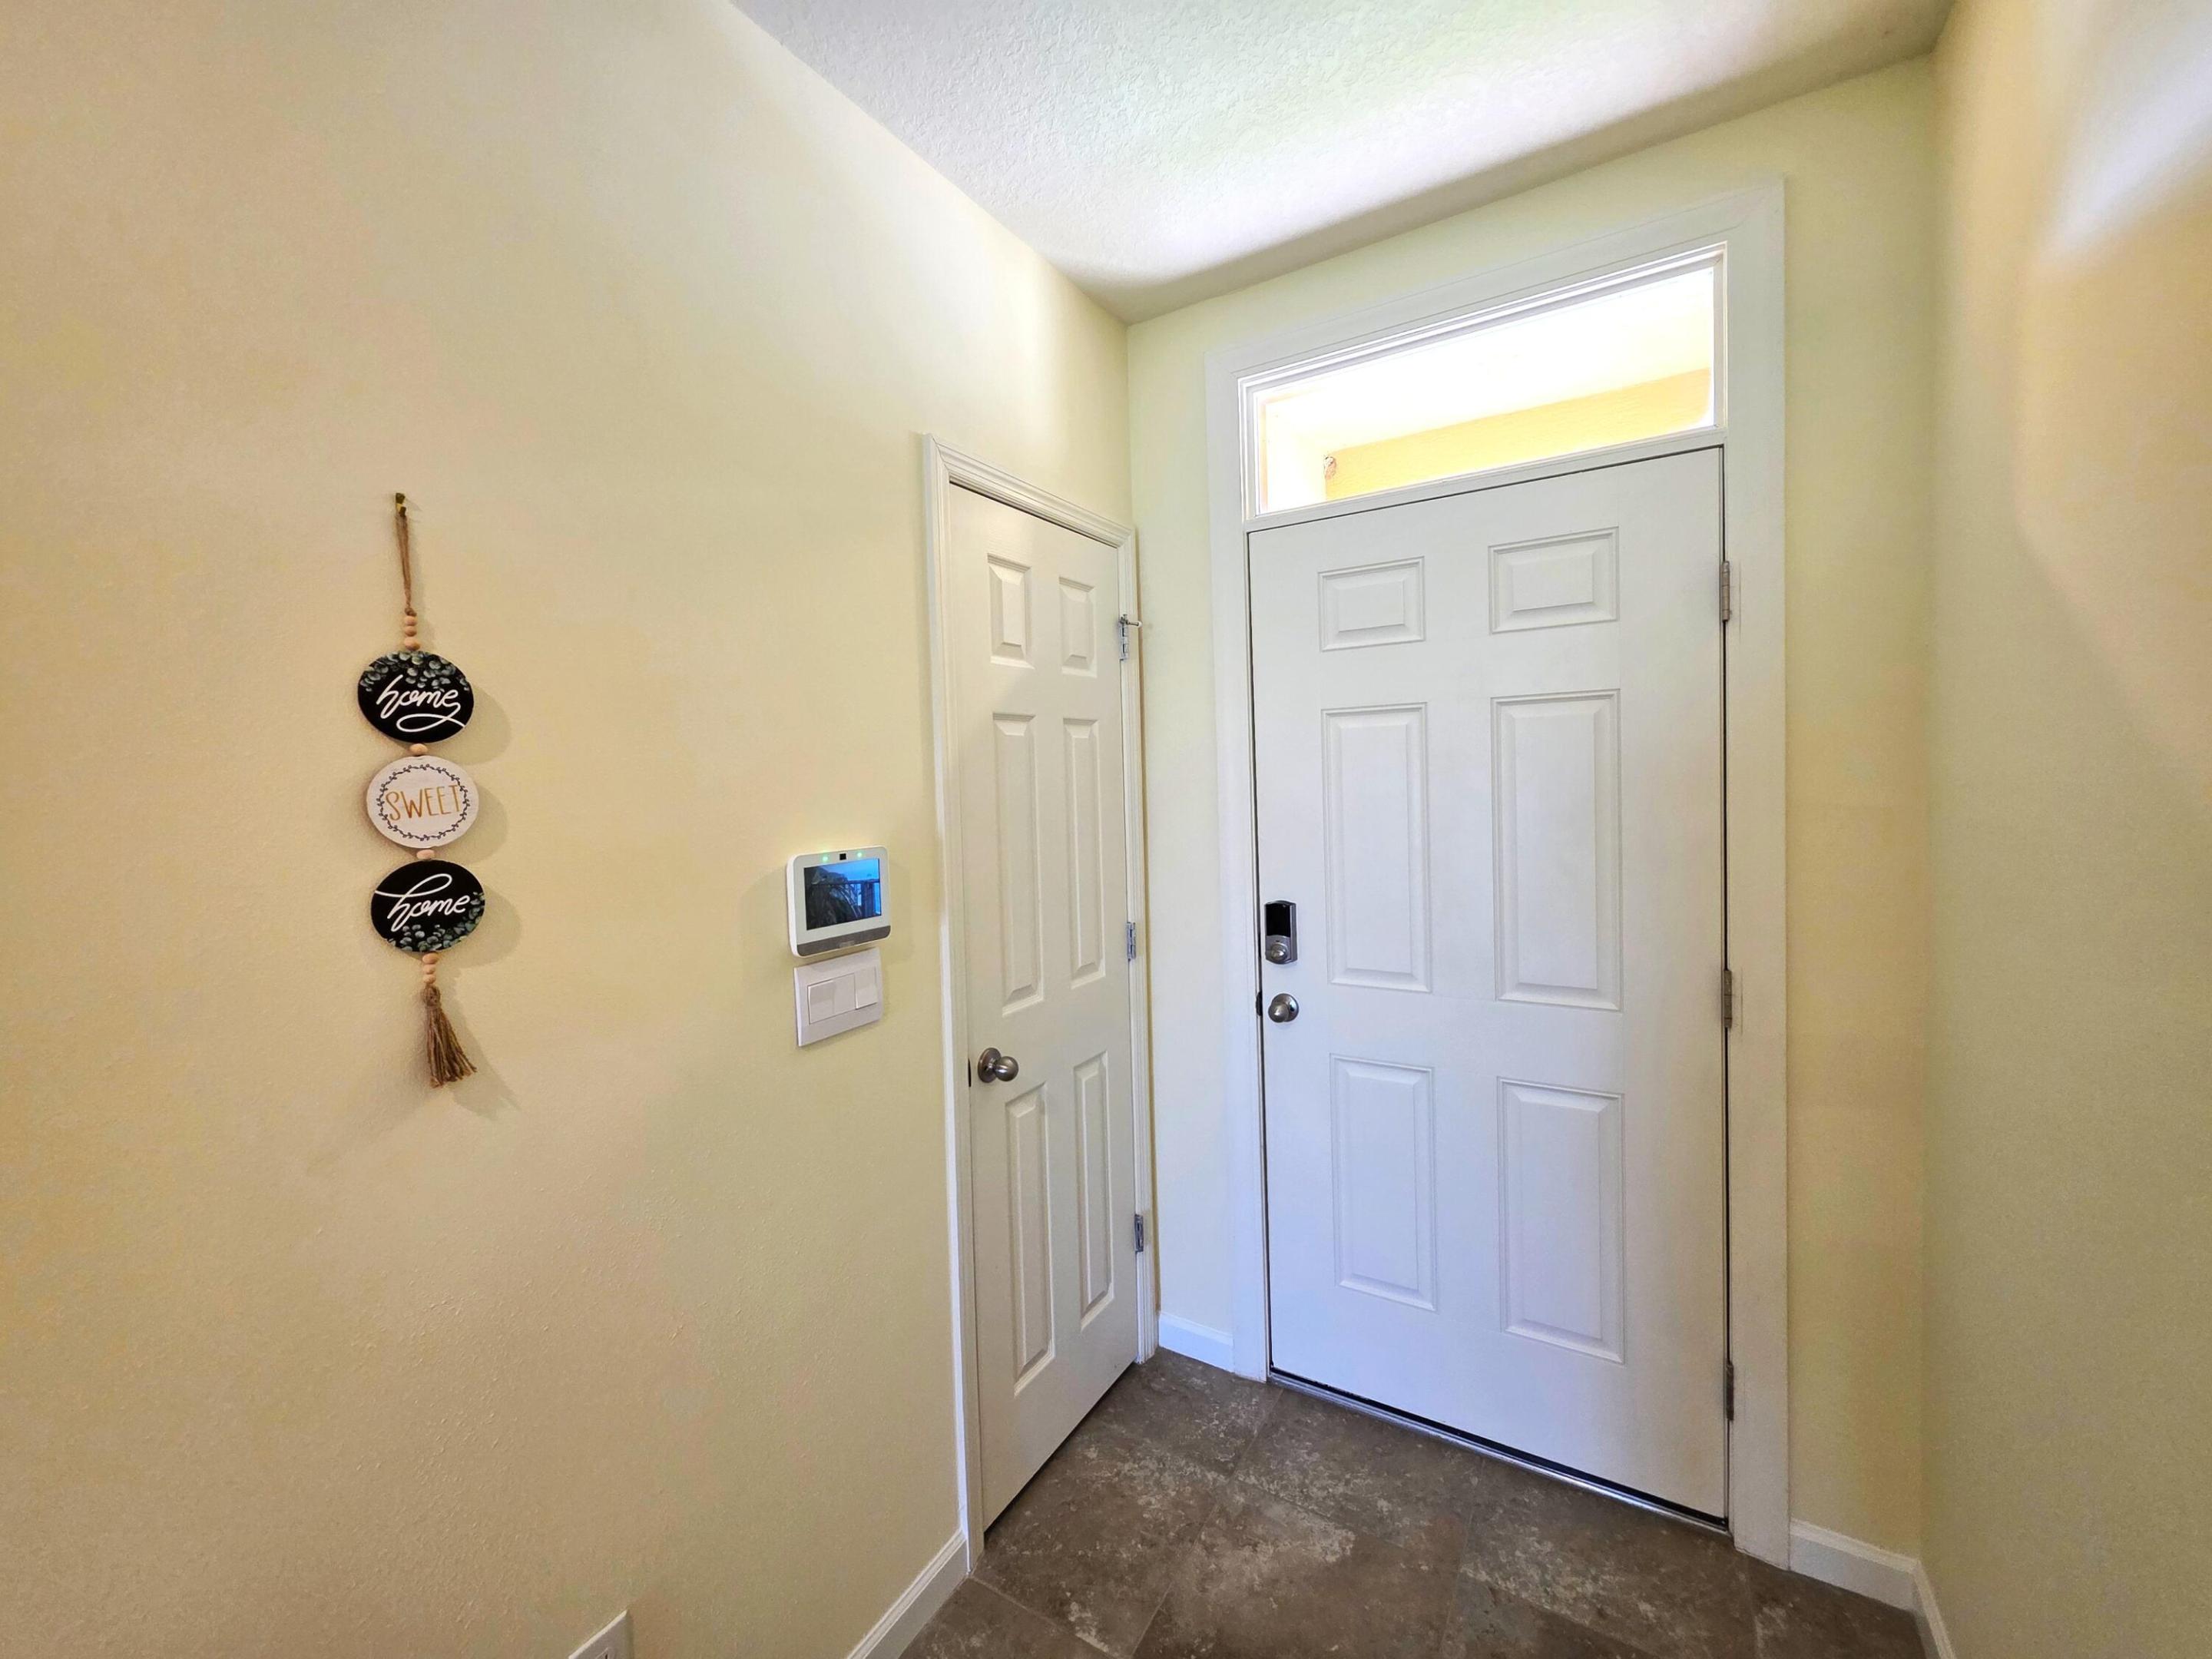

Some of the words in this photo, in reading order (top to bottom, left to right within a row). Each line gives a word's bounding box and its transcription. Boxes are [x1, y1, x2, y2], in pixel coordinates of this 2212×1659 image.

[376, 674, 465, 733] home
[385, 784, 462, 822] SWEET
[374, 873, 471, 932] home
